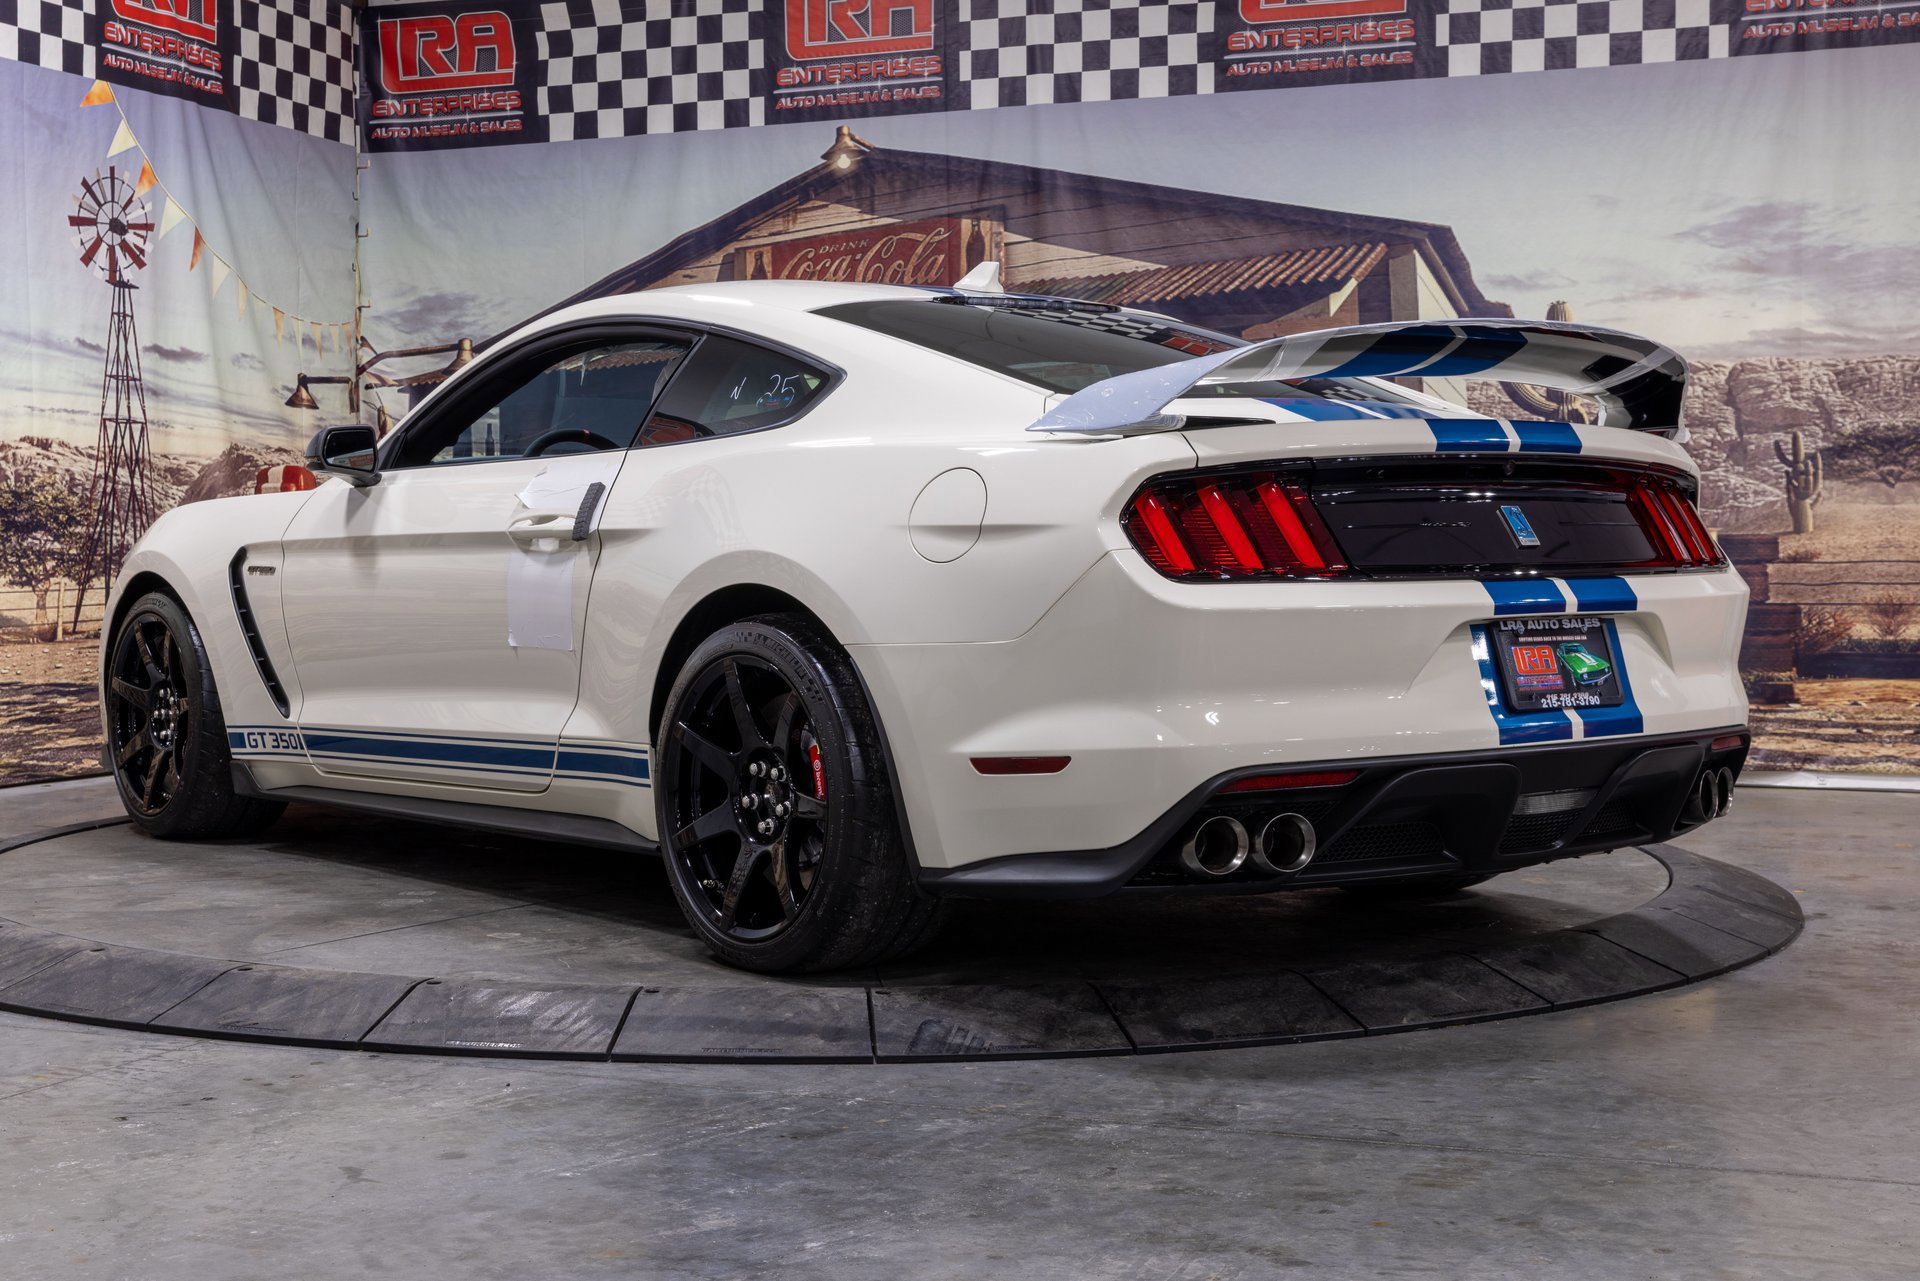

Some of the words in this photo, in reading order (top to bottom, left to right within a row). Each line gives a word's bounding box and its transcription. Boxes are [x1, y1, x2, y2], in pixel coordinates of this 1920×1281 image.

[1227, 18, 1415, 51] ENTERPRISES
[1743, 22, 1795, 38] AUTO
[1797, 15, 1879, 34] MUSEUM
[1881, 13, 1895, 28] &
[104, 21, 222, 71] ENTERPRISES
[377, 10, 516, 94] LRA
[103, 53, 134, 72] AUTO
[134, 60, 183, 82] MUSEUM
[191, 74, 224, 95] SALES
[776, 55, 942, 86] ENTERPRISES
[1226, 61, 1271, 76] AUTO
[1273, 56, 1344, 73] MUSEUM
[1346, 54, 1358, 68] &
[1360, 51, 1414, 67] SALES
[372, 90, 522, 117] ENTERPRISES
[775, 95, 815, 110] AUTO
[817, 91, 879, 107] MUSEUM
[881, 89, 892, 103] &
[893, 86, 941, 100] SALES
[371, 126, 411, 139] AUTO
[412, 122, 468, 137] MUSEUM
[469, 122, 479, 134] &
[480, 119, 523, 133] SALES
[779, 227, 952, 284] Coca-Cola
[819, 238, 870, 255] DRINK
[755, 374, 799, 408] 25
[1500, 620, 1525, 631] LRA
[1527, 619, 1559, 630] AUTO
[1562, 618, 1600, 629] SALES
[1512, 645, 1558, 675] LRA
